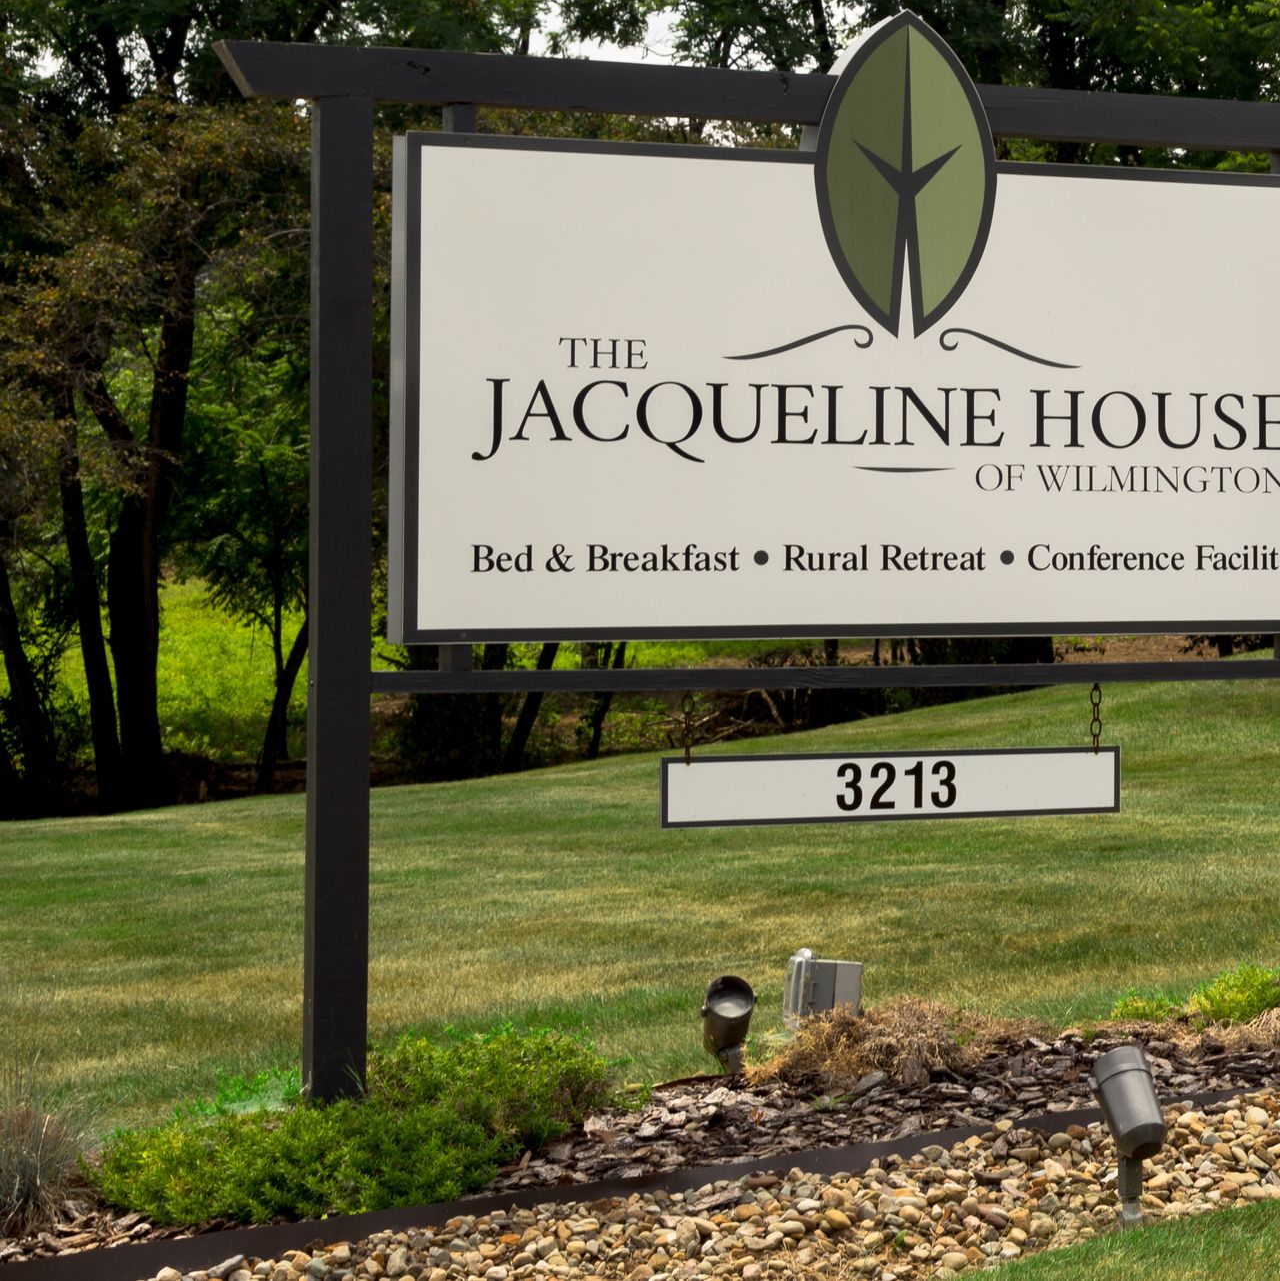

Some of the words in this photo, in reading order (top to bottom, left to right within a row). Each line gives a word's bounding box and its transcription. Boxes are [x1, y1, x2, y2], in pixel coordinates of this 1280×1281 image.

[559, 337, 648, 369] THE
[472, 378, 1004, 464] JACQUELINE
[974, 464, 1024, 492] OF
[471, 545, 533, 572] Bed
[546, 544, 575, 572] &
[587, 544, 739, 572] Breakfast
[784, 544, 868, 571] Rural
[881, 545, 985, 571] Retreat
[1028, 544, 1184, 571] Conference
[836, 760, 957, 811] 3213
